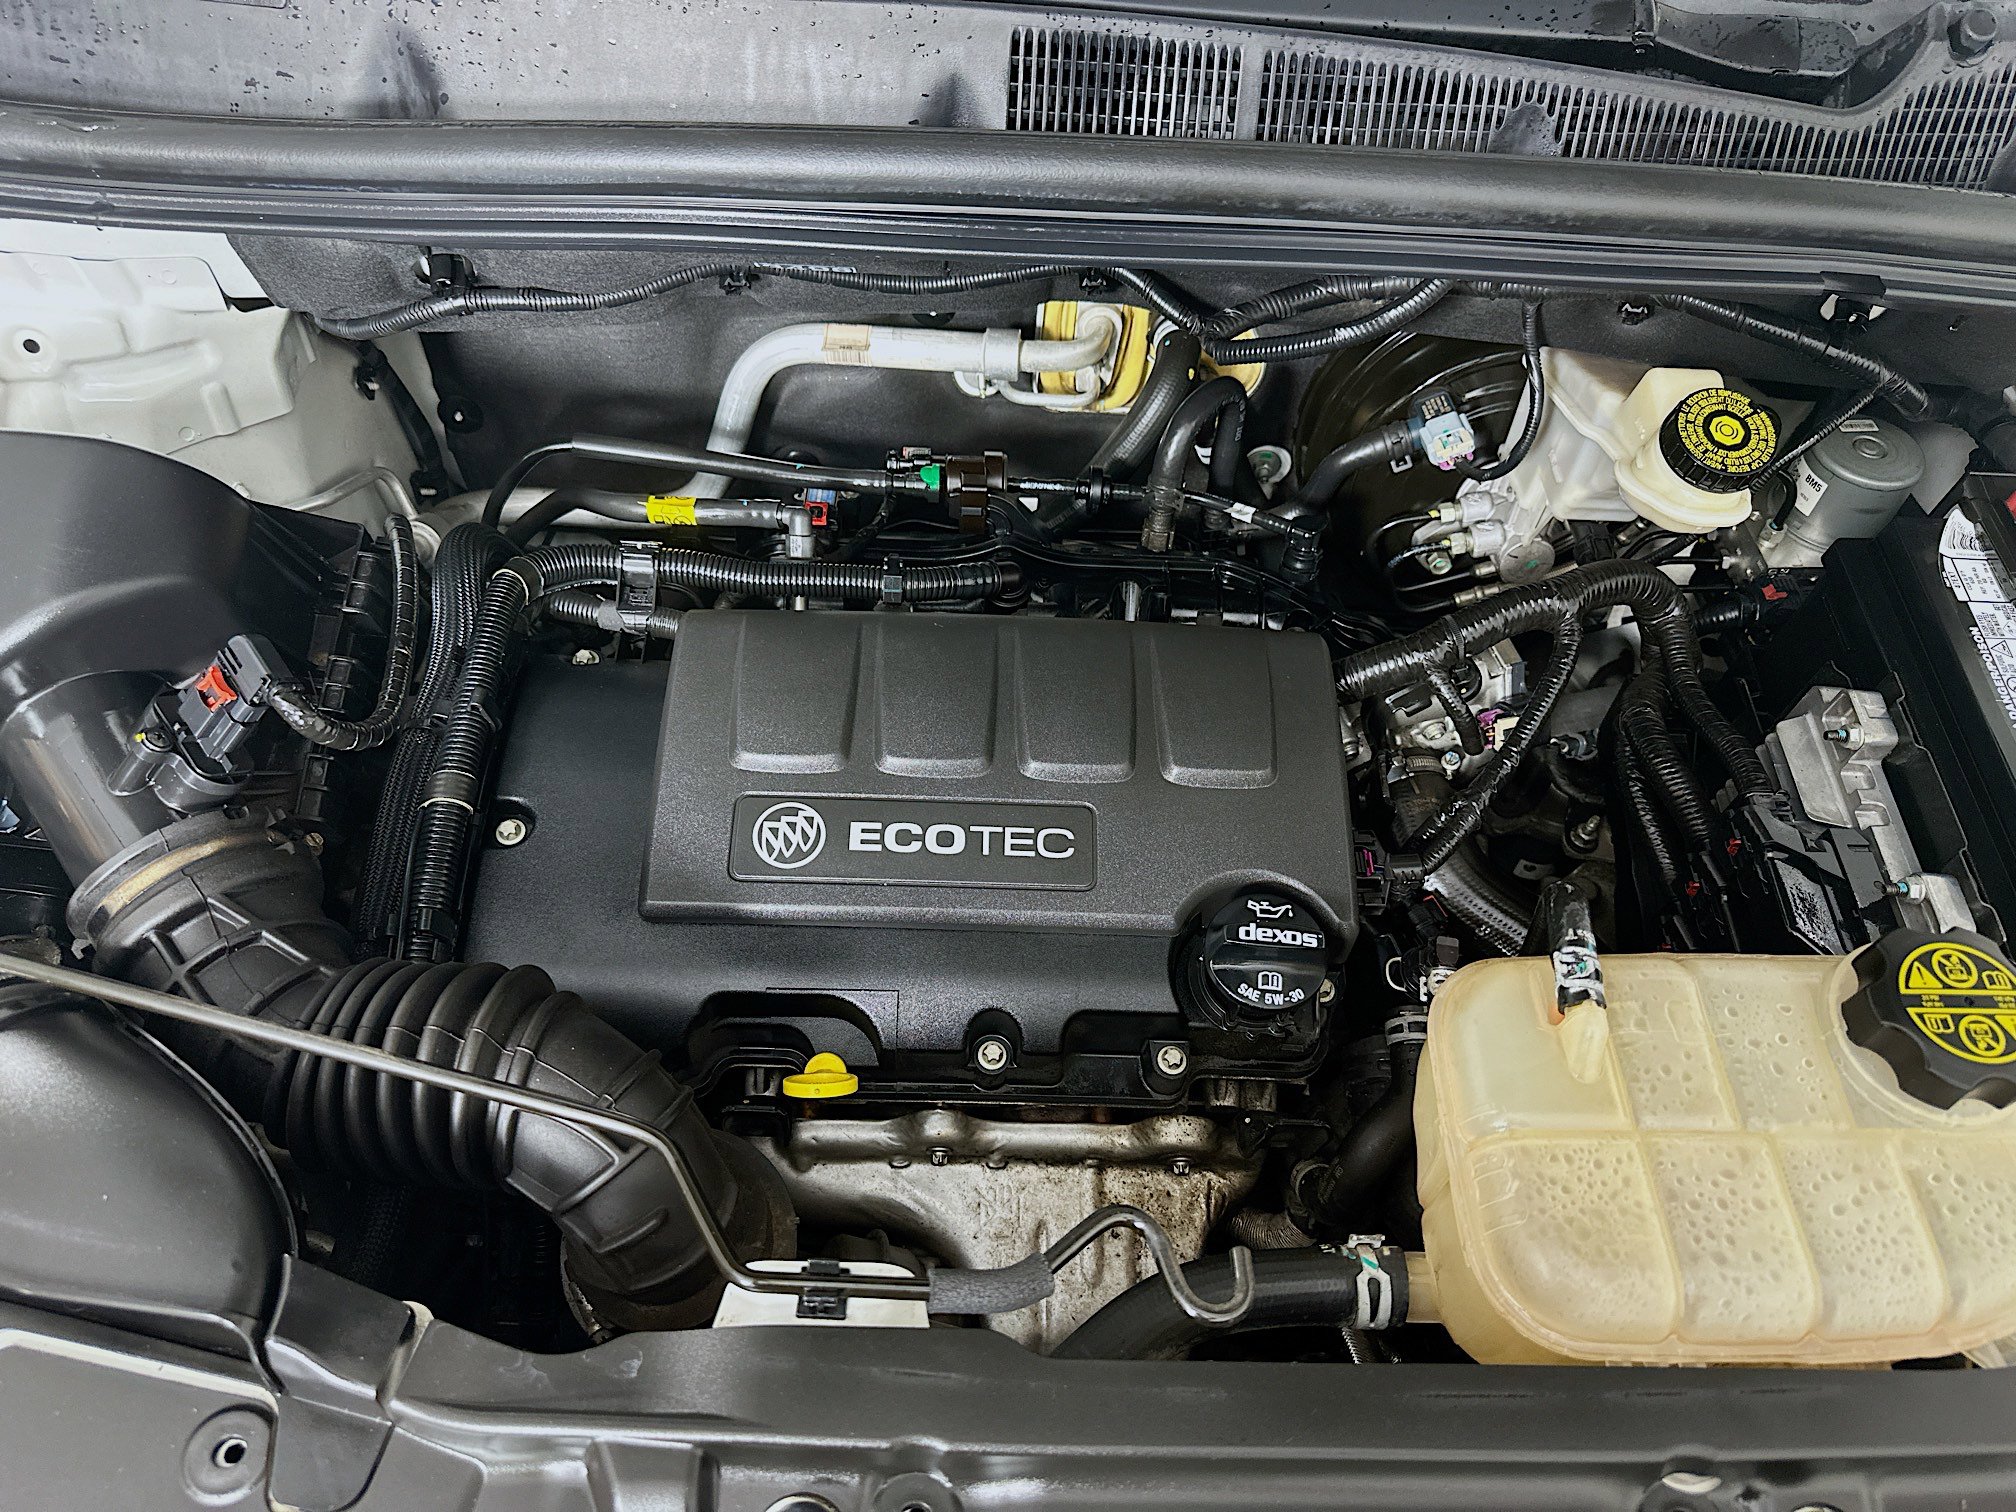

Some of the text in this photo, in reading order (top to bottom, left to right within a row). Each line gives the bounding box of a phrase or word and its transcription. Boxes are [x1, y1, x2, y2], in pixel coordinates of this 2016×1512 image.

[1685, 390, 1709, 406] BOUCHON
[1681, 404, 1690, 413] LE
[1696, 444, 1706, 452] DE
[1759, 446, 1774, 463] FILLER
[1727, 464, 1751, 472] BEFORE
[1749, 459, 1764, 470] CAP
[1969, 626, 2016, 720] DANGER/POISON
[849, 821, 1075, 859] ECOTEC
[1238, 923, 1318, 948] dexos
[1237, 983, 1305, 1006] SAE 5W-30
